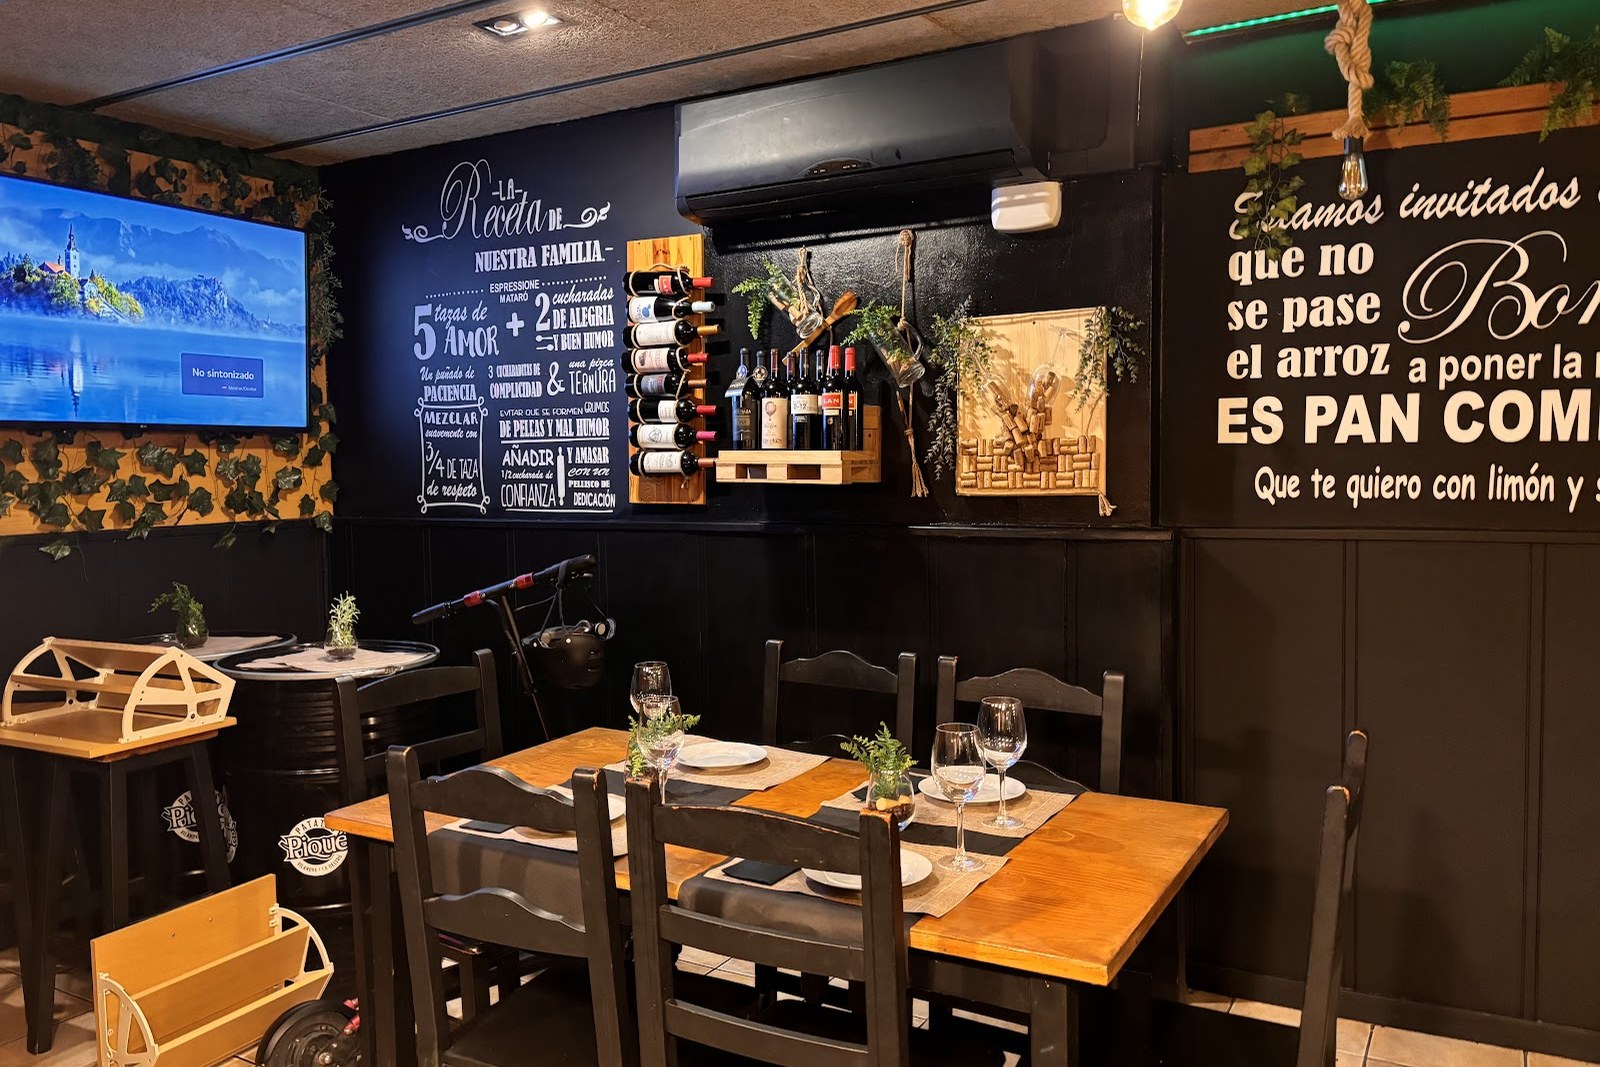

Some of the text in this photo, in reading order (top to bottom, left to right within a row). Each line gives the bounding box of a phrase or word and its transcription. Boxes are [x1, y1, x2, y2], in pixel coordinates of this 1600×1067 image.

[440, 159, 548, 239] Receta
[1229, 166, 1581, 240] Eamos invitados
[549, 207, 563, 231] DE
[475, 246, 538, 273] NUESTRA
[1228, 242, 1374, 286] que no
[489, 279, 540, 294] ESPRESSIONE
[552, 283, 614, 305] cucharadas
[500, 291, 529, 304] MATARÓ
[434, 300, 488, 330] tazas de
[535, 292, 551, 332] 2
[553, 308, 567, 330] DE
[569, 304, 615, 328] ALEGRIA
[1227, 290, 1381, 333] se pase
[413, 303, 437, 361] 5
[444, 325, 500, 358] AMOR
[553, 330, 615, 351] Y BUEN HUMOR
[488, 363, 541, 379] 3 CUCHARADITAS DE
[568, 357, 615, 371] una pizca
[1227, 343, 1391, 380] el arroz
[1408, 357, 1427, 382] a
[1439, 350, 1543, 390] poner
[1553, 343, 1582, 380] la
[192, 367, 255, 380] No sintonizado
[420, 365, 475, 384] Un puñado de
[424, 383, 477, 402] PACIENCIA
[490, 381, 543, 399] COMPLICIDAD
[423, 411, 479, 425] MEZCLAR
[500, 407, 583, 417] EVITAR QUE SE FORMEN
[584, 401, 610, 414] GRUMOS
[1217, 388, 1600, 445] ES PAN COM
[425, 428, 478, 438] suavemente con
[499, 417, 610, 438] DE PELEAS Y MAL HUMOR
[502, 444, 555, 467] AÑADIR
[567, 446, 610, 464] Y AMASAR
[447, 458, 457, 479] DE
[459, 458, 479, 479] TAZA
[545, 470, 554, 479] de
[426, 480, 478, 502] de respeto
[600, 479, 611, 488] DE
[1254, 465, 1301, 506] Que
[1311, 467, 1336, 500] te
[1346, 465, 1422, 508] quiero
[1432, 474, 1476, 501] con
[1488, 462, 1555, 502] limón
[1567, 475, 1585, 513] y
[501, 483, 557, 508] CONFIANZA
[573, 489, 616, 508] DEDICACIÓN
